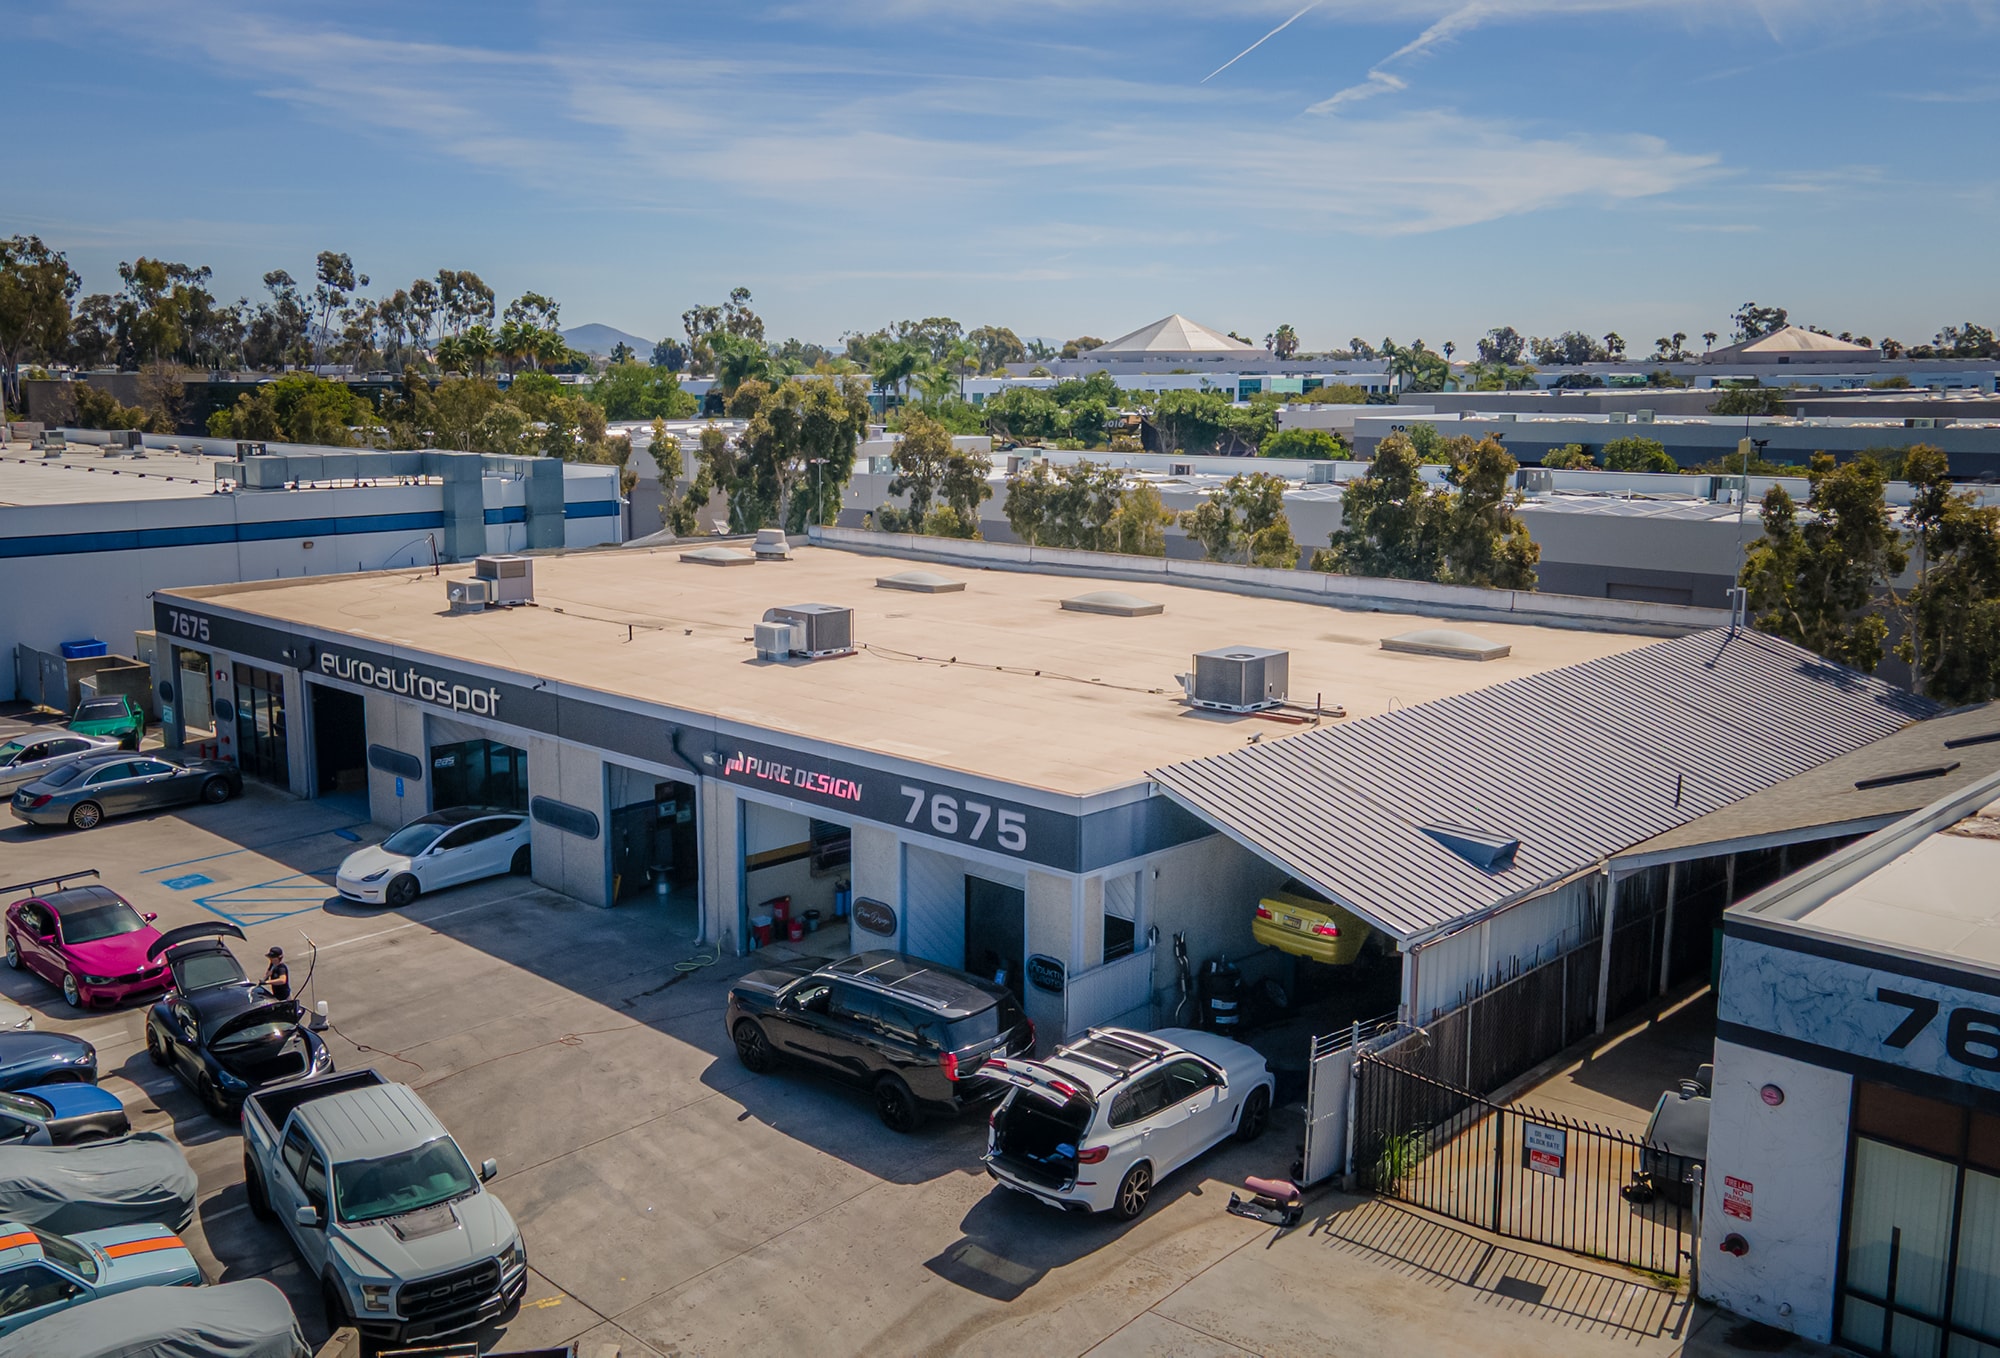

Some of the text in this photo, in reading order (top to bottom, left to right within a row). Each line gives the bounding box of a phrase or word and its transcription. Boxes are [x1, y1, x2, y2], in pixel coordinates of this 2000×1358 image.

[169, 610, 210, 641] 7675
[320, 652, 501, 717] euroautospot
[745, 756, 863, 801] PURE DESIGN
[900, 785, 1027, 852] 7675
[1876, 986, 2000, 1073] 76
[1529, 1136, 1546, 1147] BLOCK
[1544, 1133, 1555, 1141] NOT
[1732, 1189, 1744, 1197] NO
[1737, 1181, 1752, 1193] LANE
[401, 1267, 497, 1304] FORD
